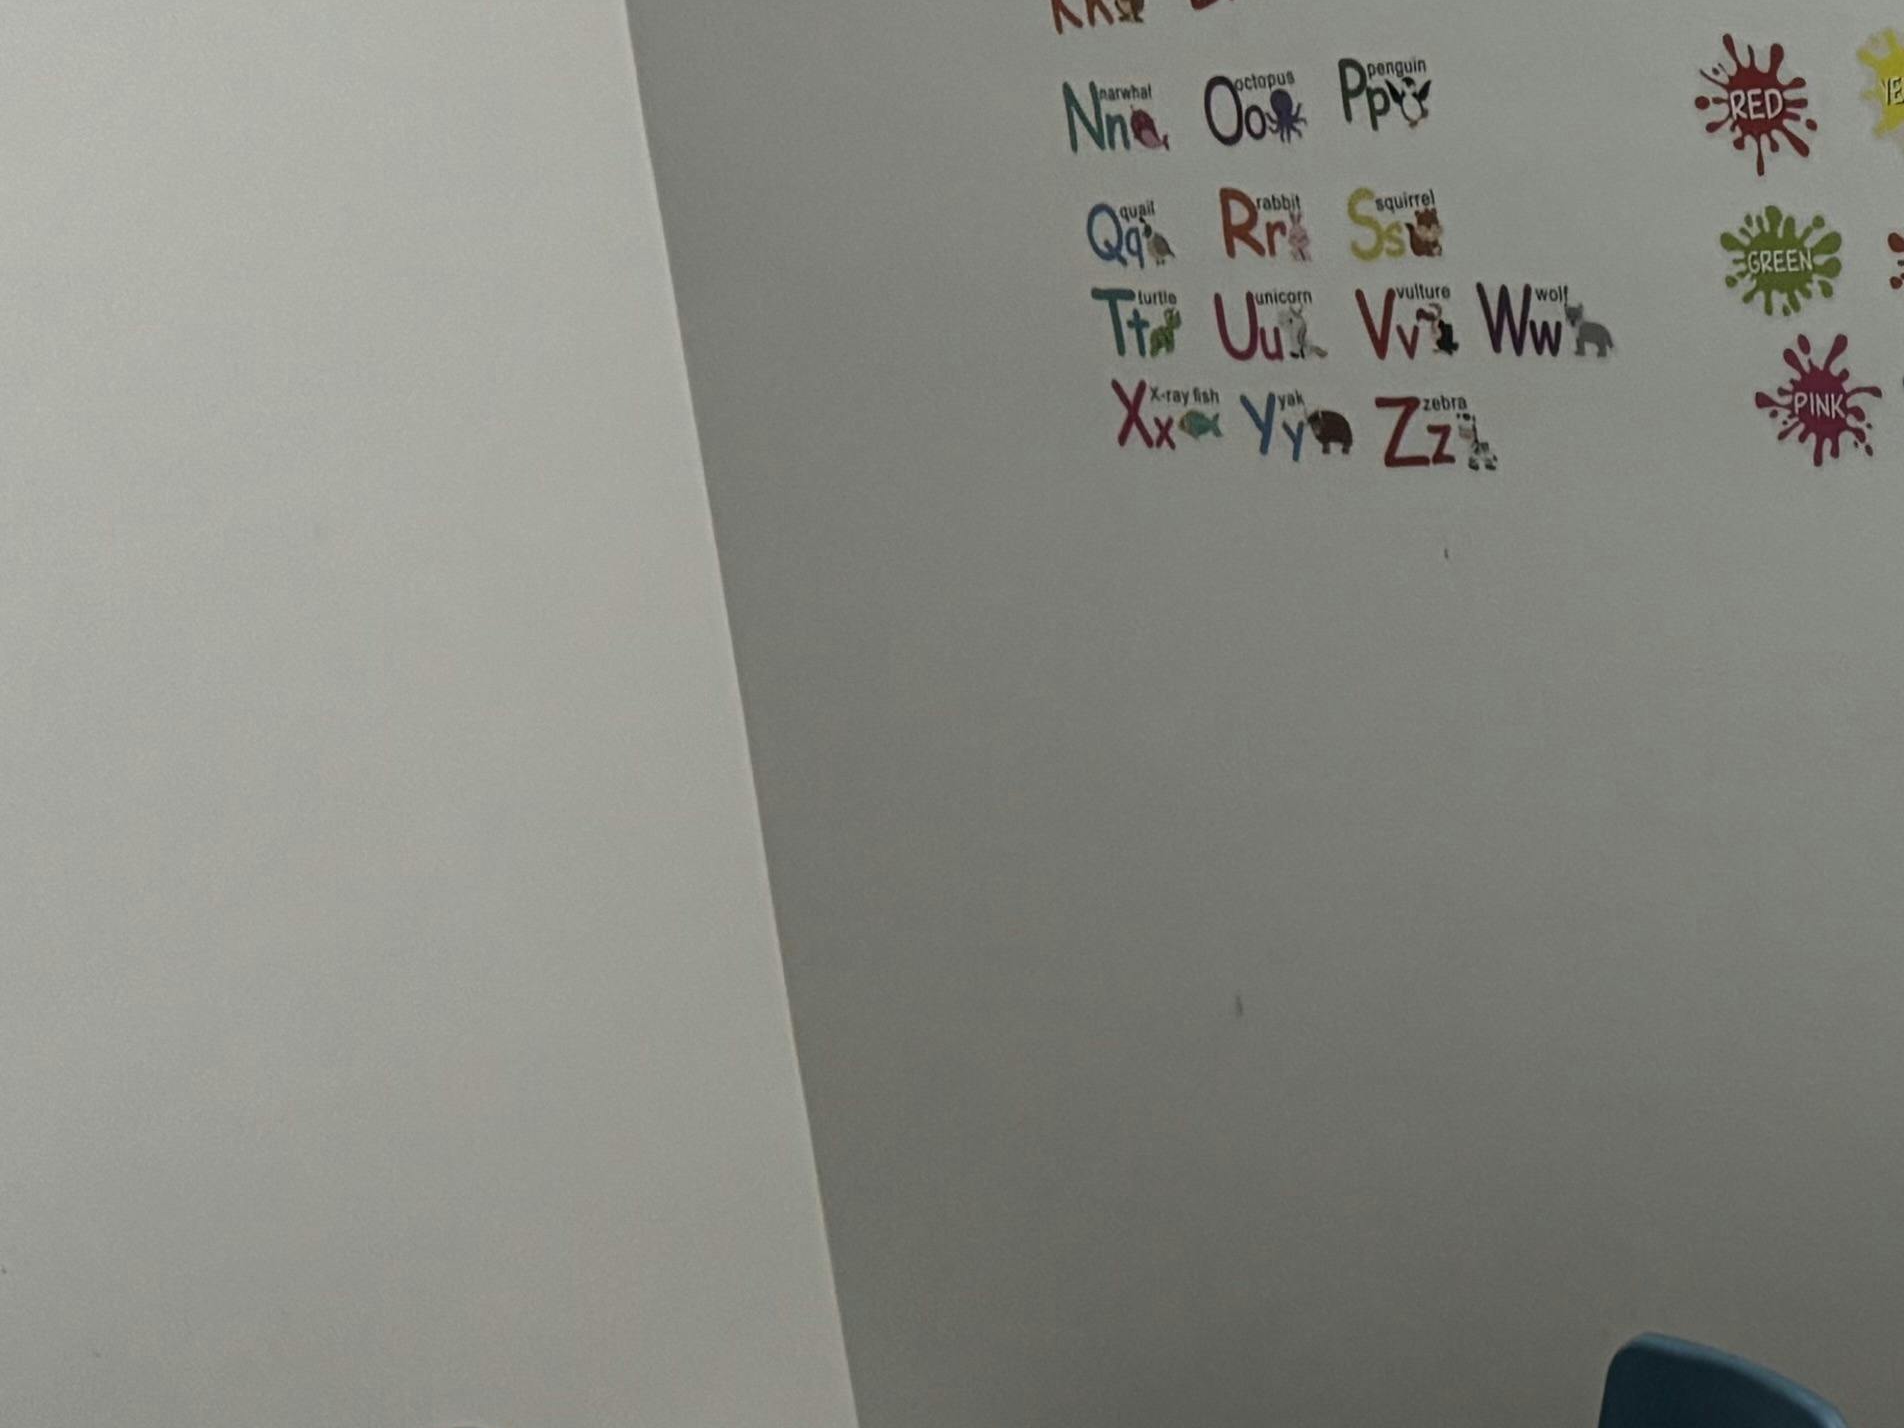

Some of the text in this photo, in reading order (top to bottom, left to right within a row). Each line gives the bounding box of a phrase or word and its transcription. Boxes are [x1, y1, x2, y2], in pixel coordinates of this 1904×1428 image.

[1235, 71, 1295, 92] octopus
[1366, 58, 1426, 78] penguin
[1100, 84, 1152, 102] narwhal
[1338, 58, 1391, 132] Pp
[1729, 87, 1784, 121] RED
[1062, 80, 1130, 153] Nn
[1204, 75, 1267, 146] Oo
[1120, 200, 1155, 221] quail
[1256, 194, 1300, 212] rabbit
[1375, 189, 1435, 212] squirrel
[1087, 203, 1145, 270] Qq
[1219, 187, 1286, 259] Rr
[1347, 187, 1405, 262] Ss
[1746, 250, 1814, 274] GREEN
[1138, 290, 1177, 307] turtle
[1256, 290, 1312, 306] unicorn
[1396, 284, 1451, 300] vulture
[1535, 285, 1568, 303] wolf
[1091, 288, 1150, 358] Tt
[1213, 291, 1283, 361] Uu
[1355, 289, 1418, 360] Vv
[1476, 282, 1562, 357] Ww
[1150, 387, 1219, 406] X-ray fish
[1423, 394, 1468, 412] zebra
[1793, 392, 1848, 419] PINK
[1111, 379, 1176, 450] Xx
[1240, 392, 1304, 462] Yy
[1375, 396, 1456, 468] Zz
